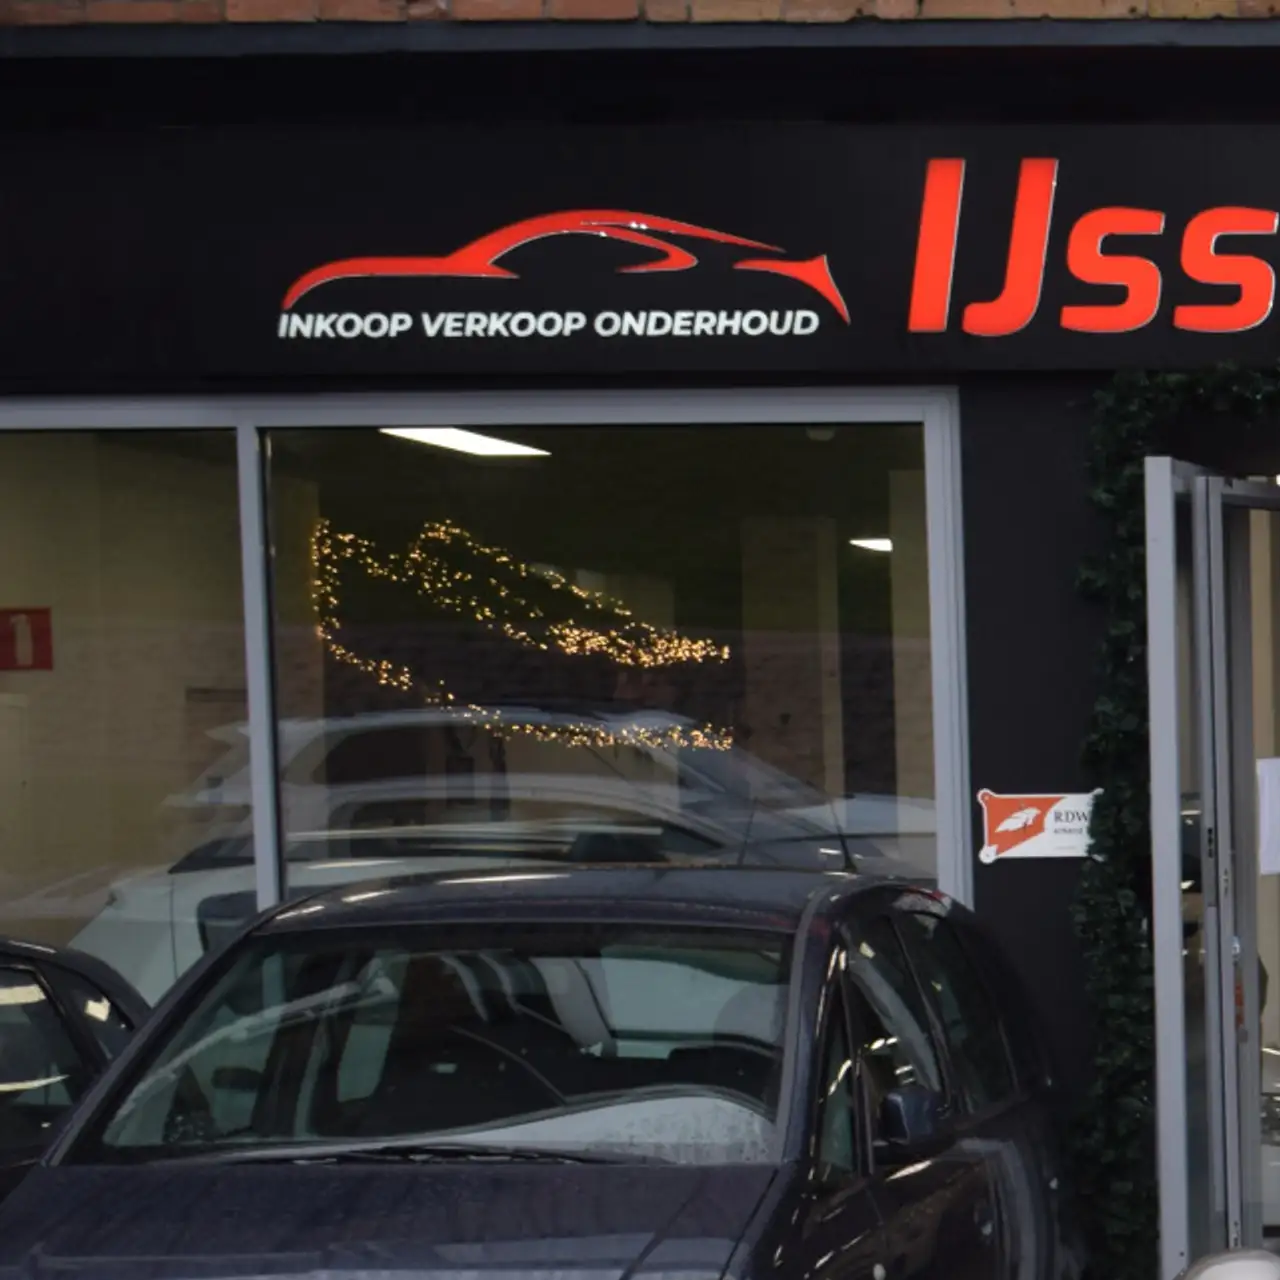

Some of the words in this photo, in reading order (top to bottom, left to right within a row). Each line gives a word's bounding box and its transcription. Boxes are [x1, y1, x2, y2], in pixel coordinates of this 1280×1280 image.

[278, 309, 412, 339] INKOOP
[421, 309, 587, 338] VERKOOP
[594, 308, 820, 337] ONDERHOUD
